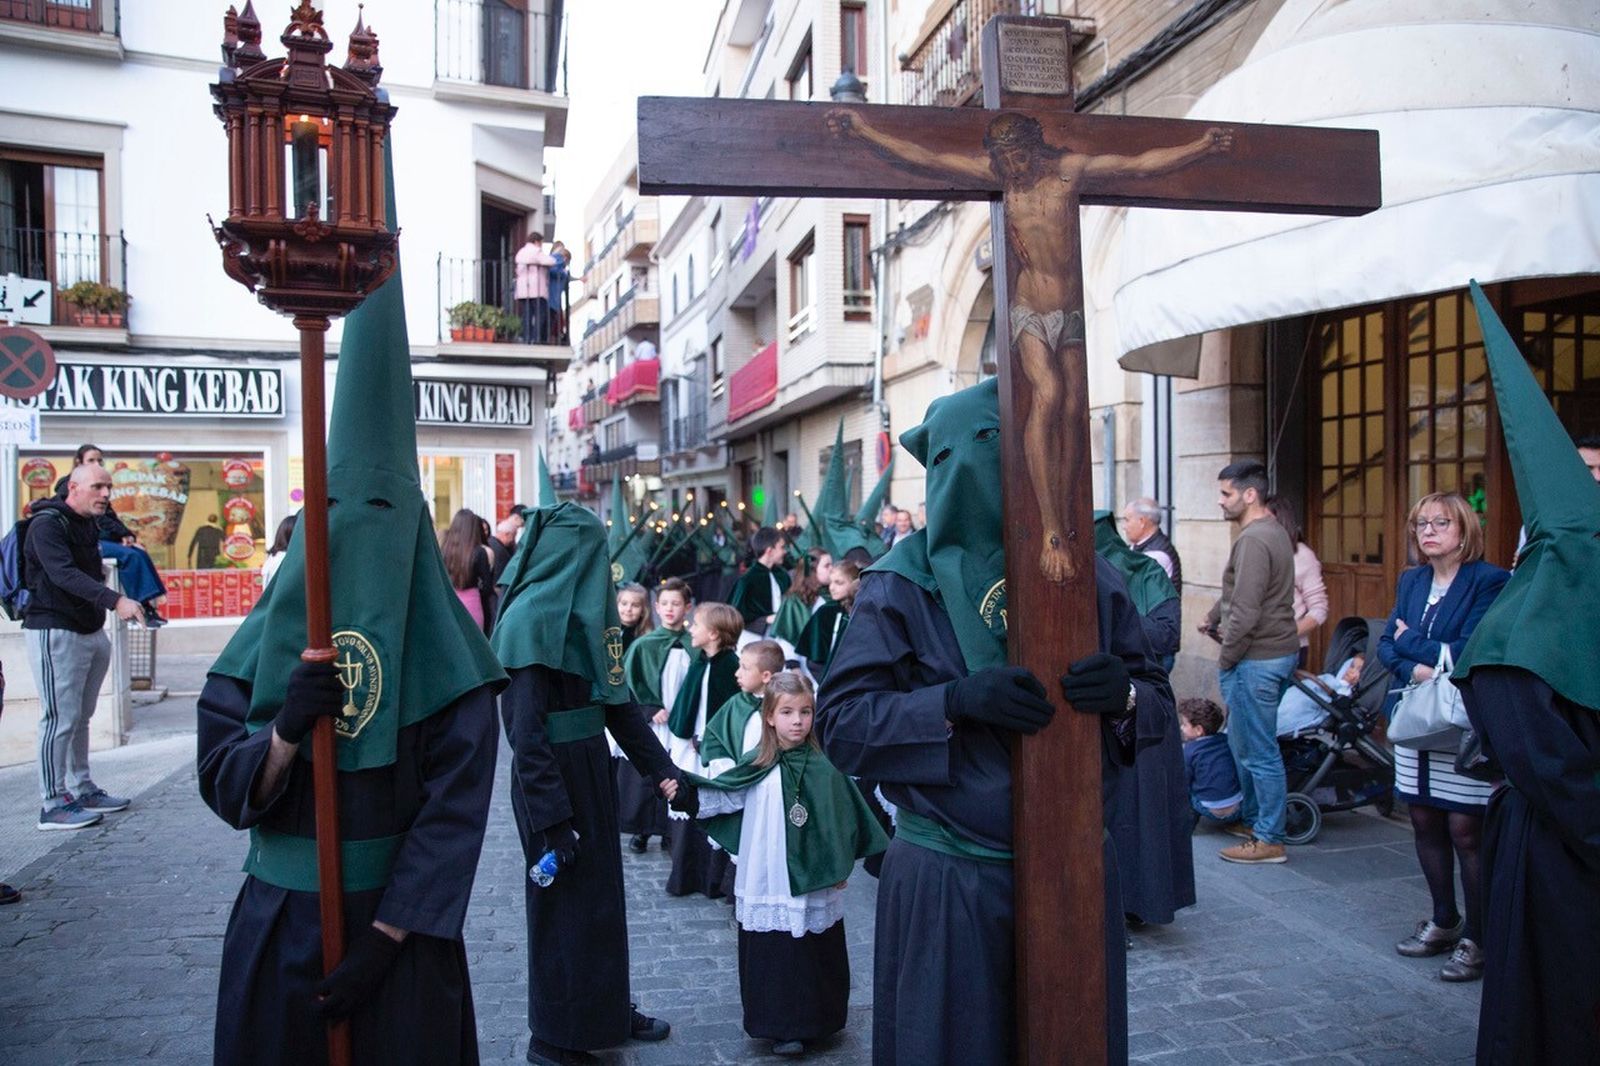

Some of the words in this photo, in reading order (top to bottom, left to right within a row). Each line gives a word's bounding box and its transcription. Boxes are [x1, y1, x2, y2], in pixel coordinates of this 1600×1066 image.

[101, 366, 179, 413] KING
[183, 368, 279, 414] KEBAB
[418, 381, 468, 422] KING
[471, 384, 530, 425] KEBAB
